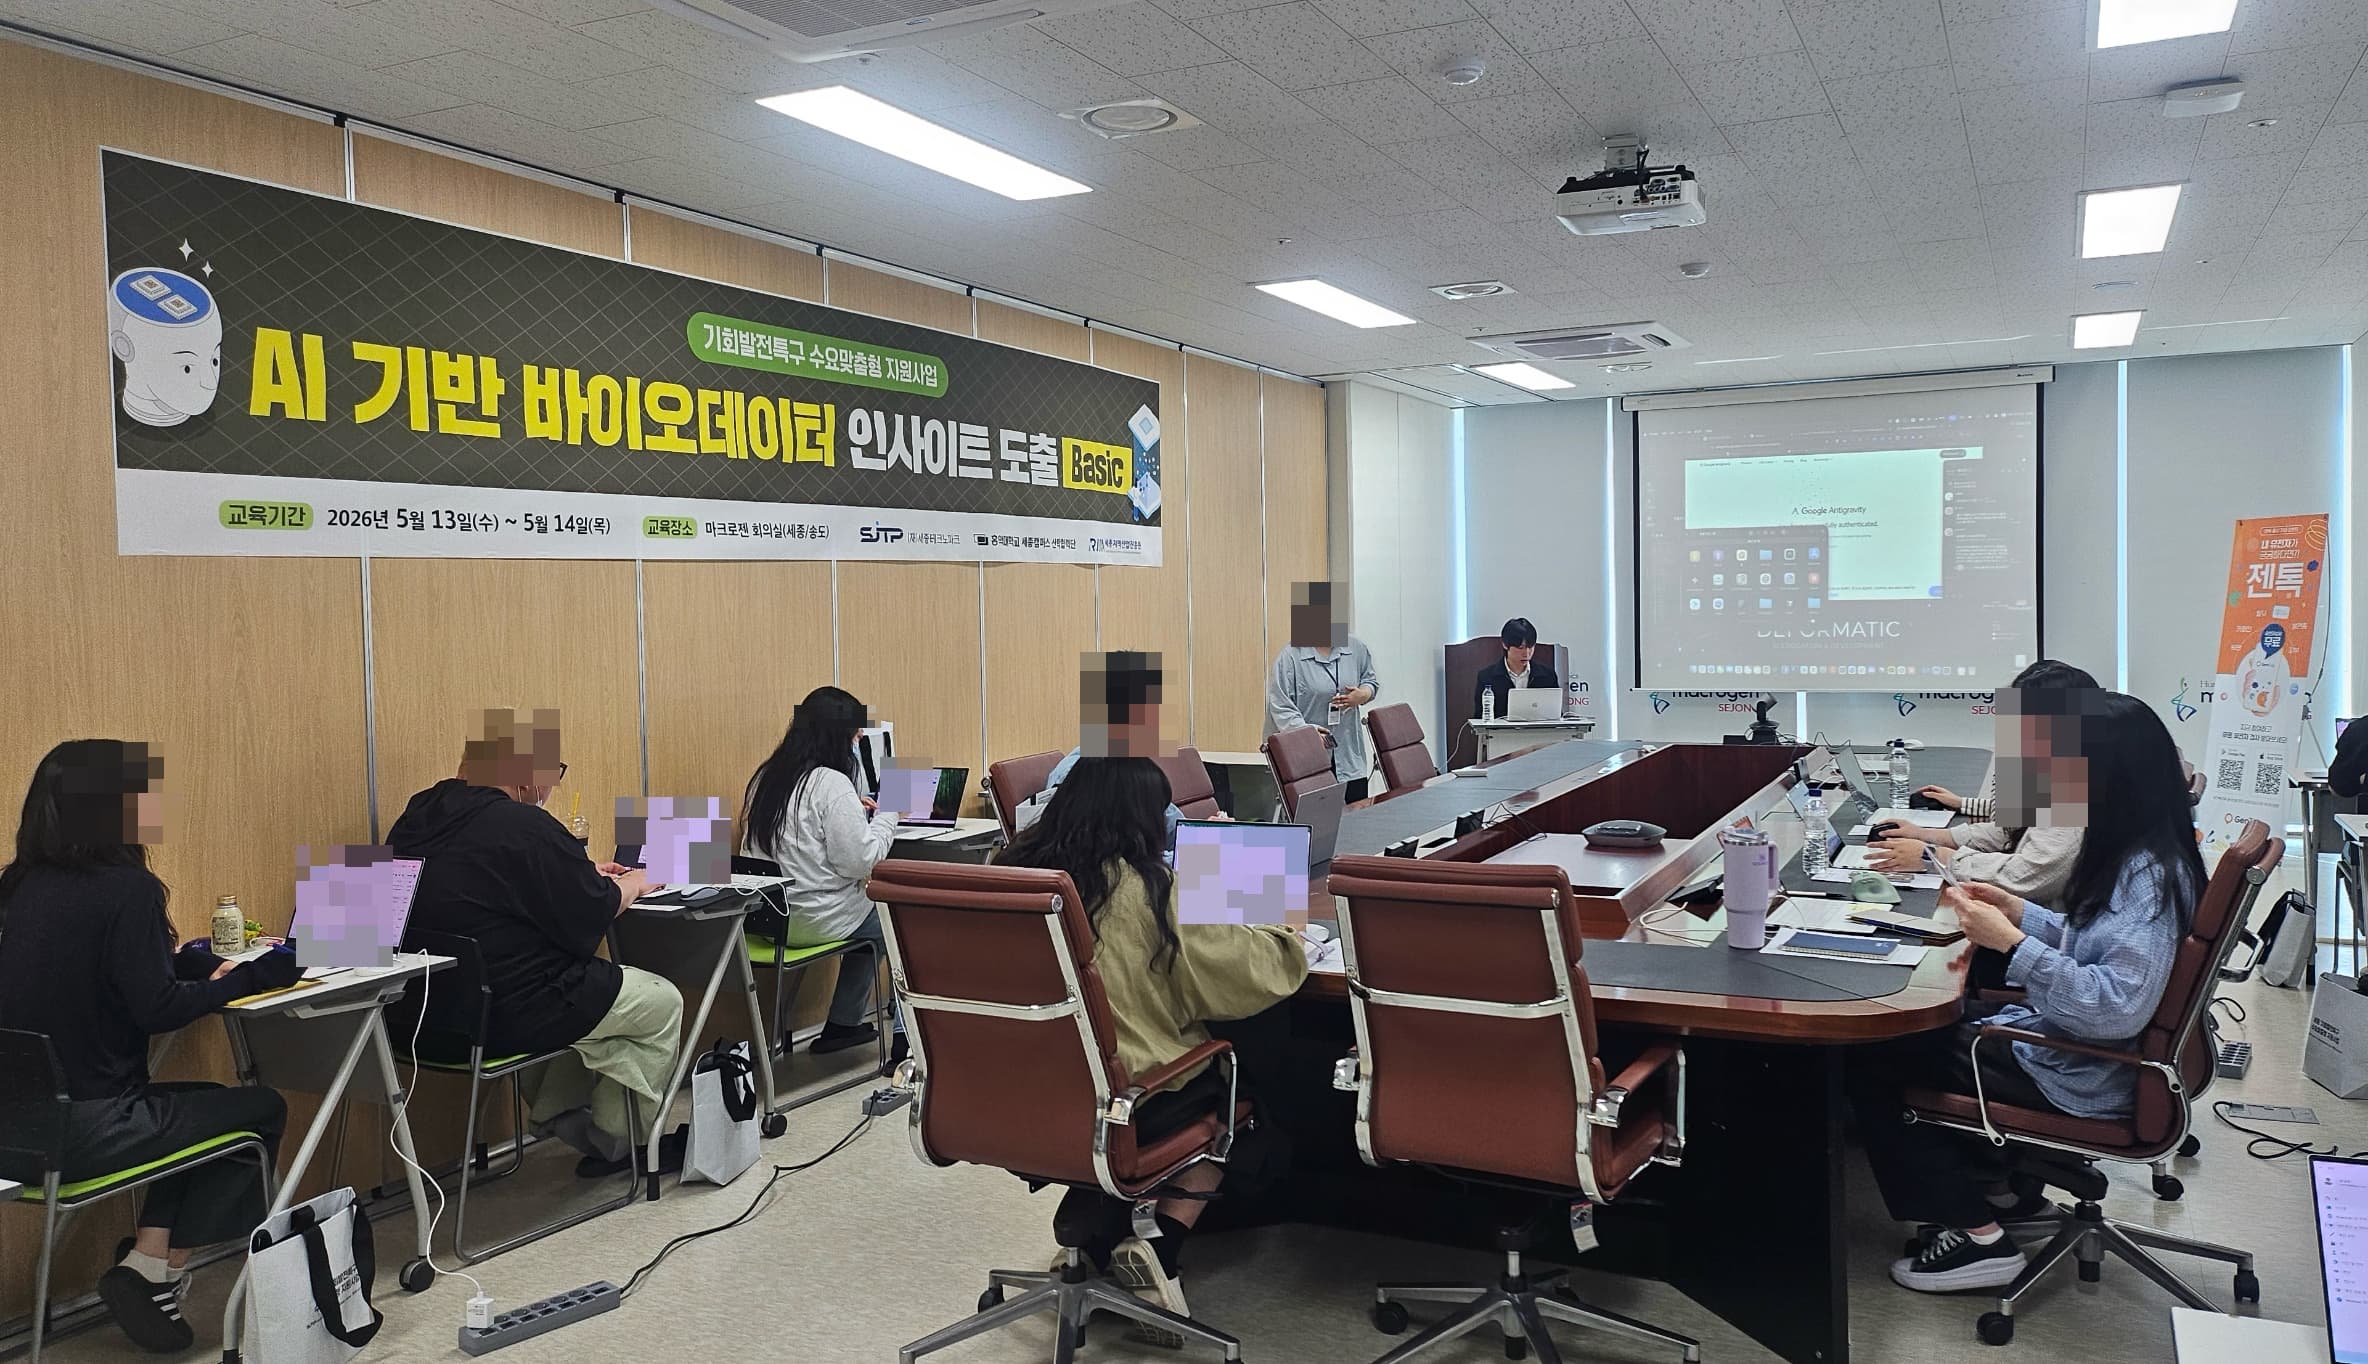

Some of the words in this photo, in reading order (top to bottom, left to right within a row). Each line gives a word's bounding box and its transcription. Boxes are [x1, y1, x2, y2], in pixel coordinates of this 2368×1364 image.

[703, 323, 806, 367] 기회발전특구
[809, 343, 882, 380] 수요맞춤형
[885, 356, 938, 388] 지원사업
[249, 326, 327, 422] AI
[352, 341, 505, 439] 기반
[523, 363, 836, 468] 바이오데이터
[848, 406, 993, 481] 인사이트
[1000, 430, 1060, 488] 도출
[1071, 440, 1126, 490] Basic
[228, 504, 306, 527] 교육기간
[1801, 506, 1828, 516] Google
[1829, 505, 1867, 515] Antigravity
[327, 509, 390, 529] 2026년
[397, 507, 425, 531] 5월
[431, 509, 500, 532] 13일(수)
[524, 512, 549, 533] 5월
[554, 514, 611, 535] 14일(목)
[647, 519, 694, 537] 교육장소
[705, 521, 750, 538] 마크로젠
[752, 522, 830, 540] 회의실(세종/송도)
[2246, 562, 2305, 598] 젠톡
[2263, 636, 2281, 648] 무료
[1568, 697, 1590, 706] ONG
[1919, 692, 1995, 704] macrog
[1718, 703, 1752, 712] SEJON
[1971, 705, 1996, 715] SEJO
